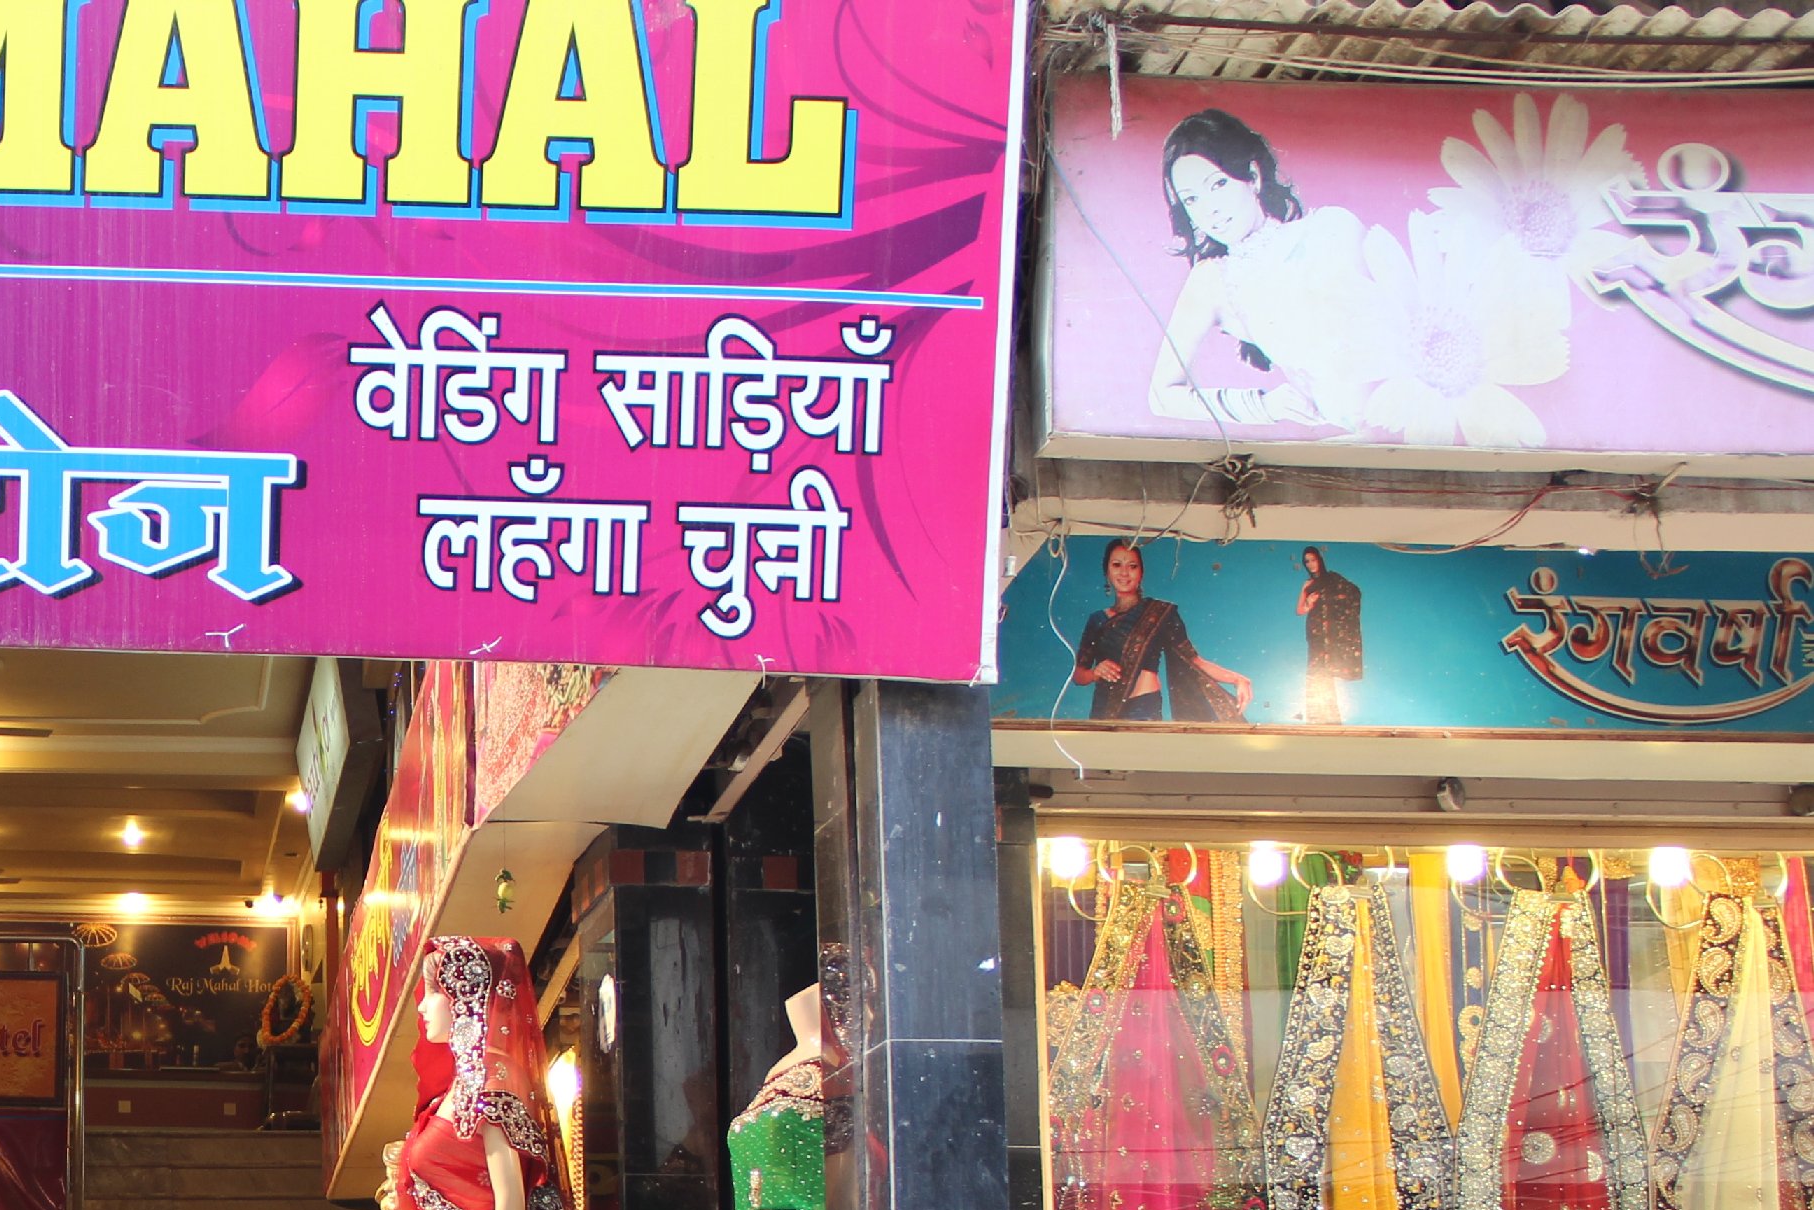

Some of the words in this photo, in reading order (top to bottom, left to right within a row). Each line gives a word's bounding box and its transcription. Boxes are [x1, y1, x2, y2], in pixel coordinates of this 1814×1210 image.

[348, 302, 568, 446] वेडिंग
[418, 455, 648, 602] लहँगा
[676, 464, 853, 641] चुन्नी
[166, 976, 193, 997] Raj
[197, 977, 241, 995] Mahal
